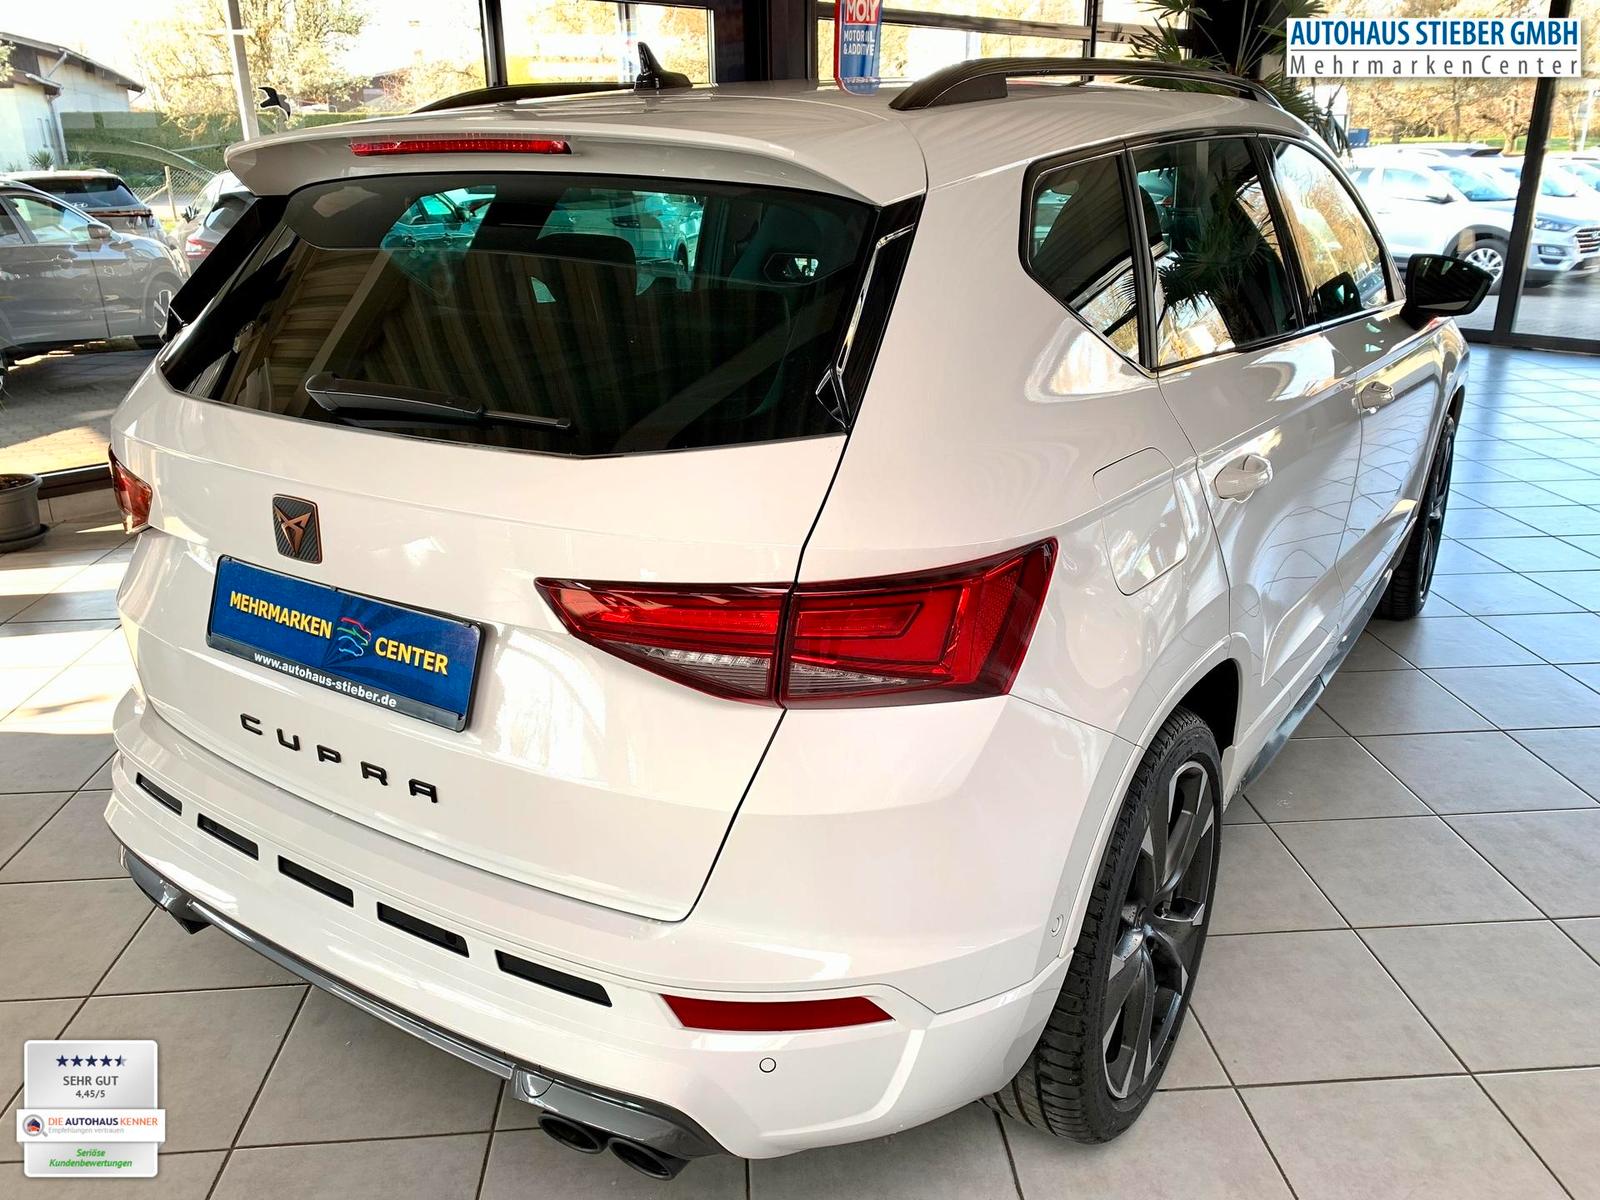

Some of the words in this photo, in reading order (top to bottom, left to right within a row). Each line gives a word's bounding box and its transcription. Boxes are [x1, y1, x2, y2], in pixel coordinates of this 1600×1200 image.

[845, 0, 880, 22] MOLY
[229, 590, 333, 640] MEHRMARKEN
[375, 636, 449, 676] CENTER
[254, 651, 397, 708] www.autohaus-stieber.de
[240, 712, 439, 804] CUPRA
